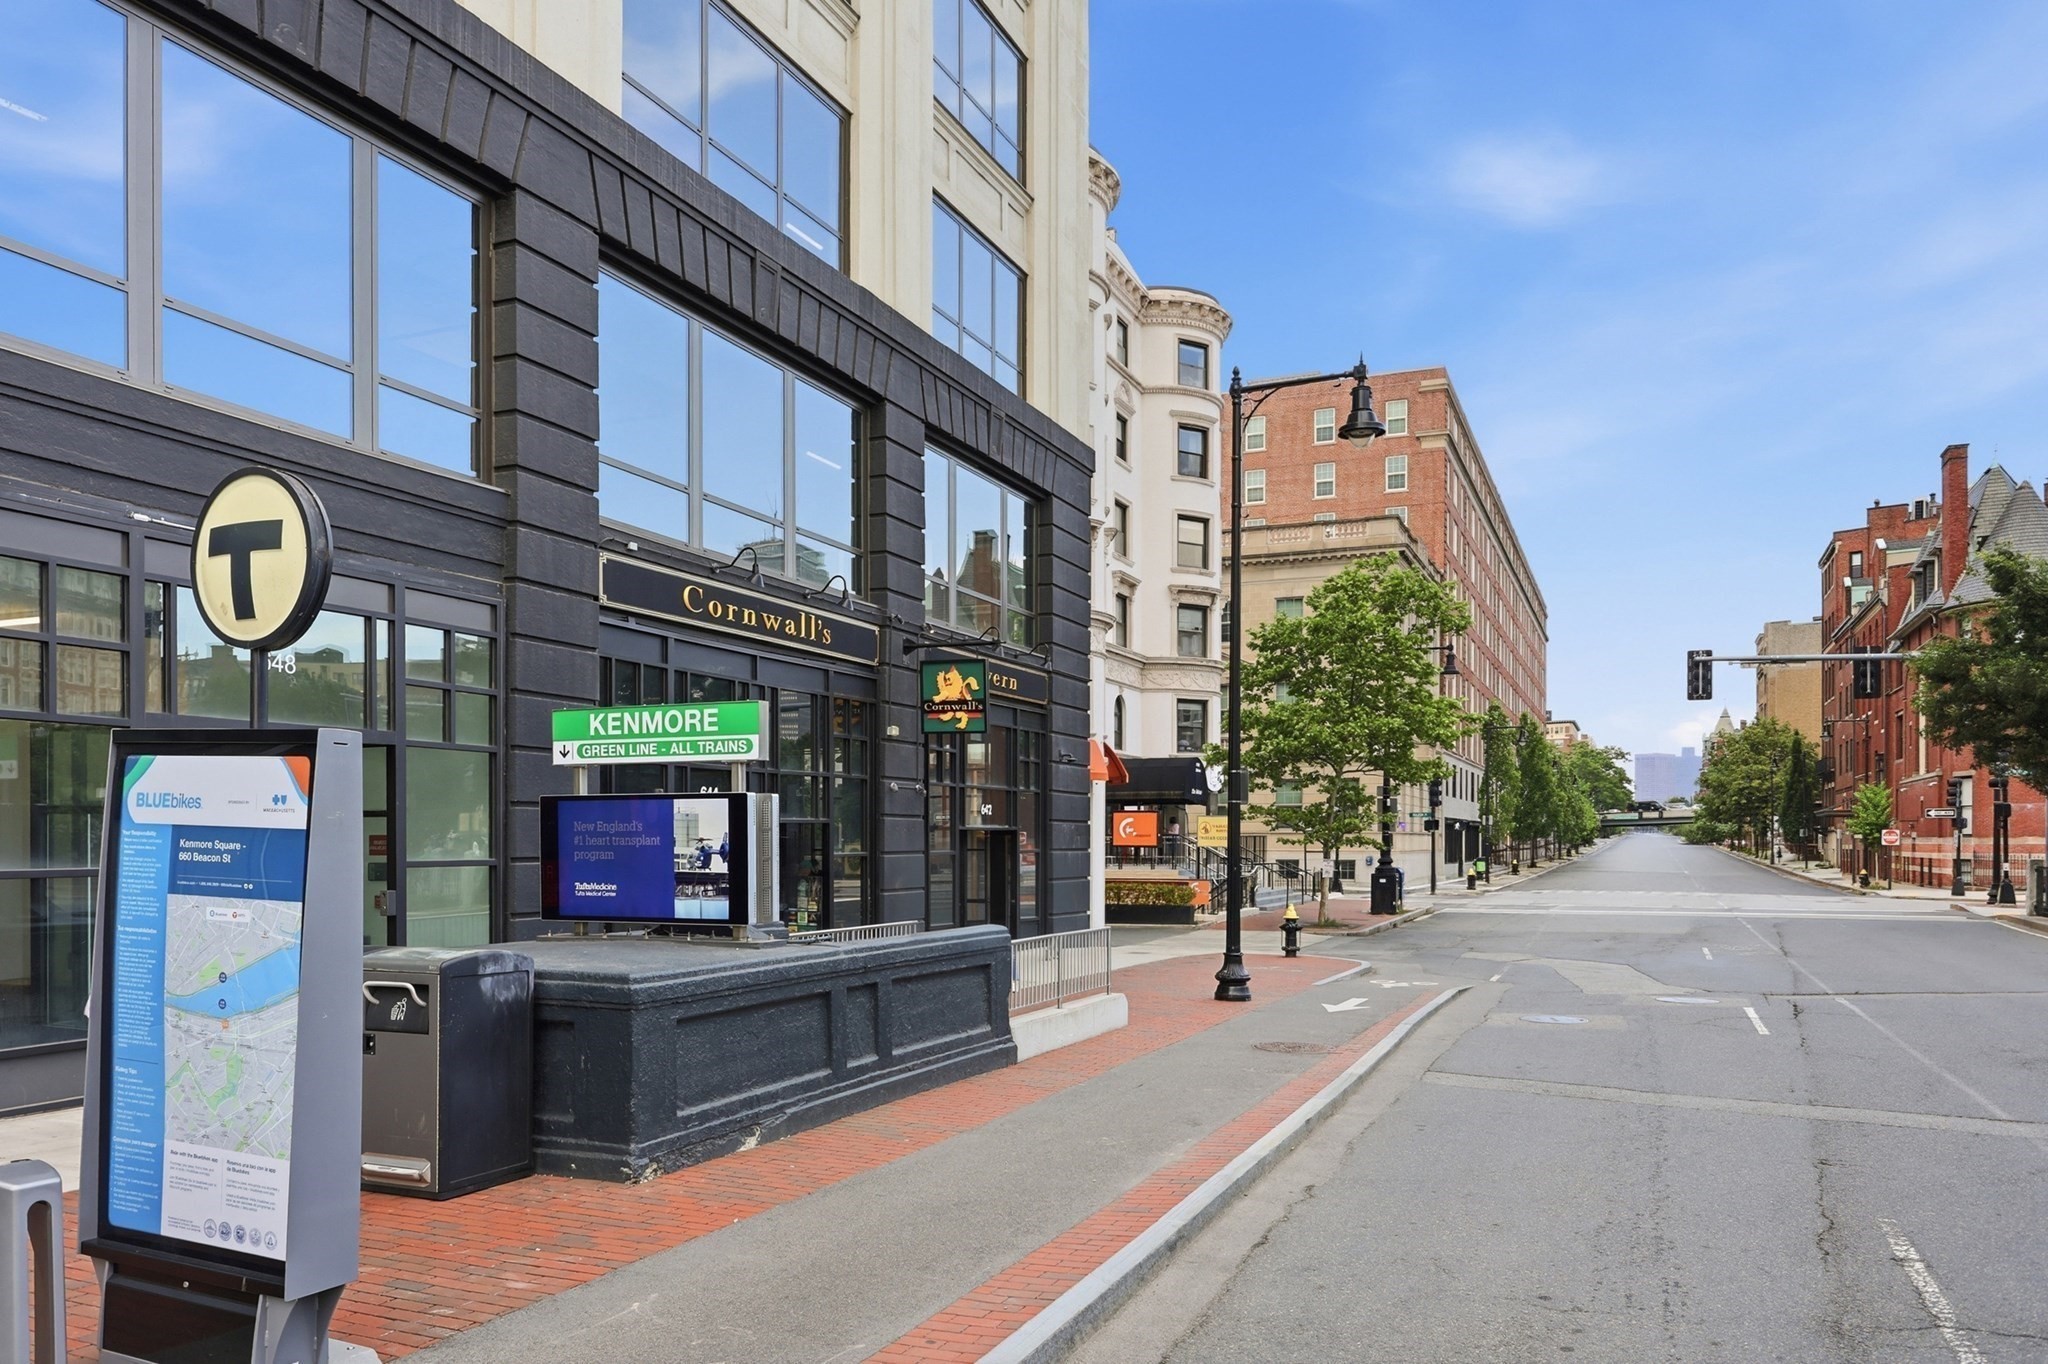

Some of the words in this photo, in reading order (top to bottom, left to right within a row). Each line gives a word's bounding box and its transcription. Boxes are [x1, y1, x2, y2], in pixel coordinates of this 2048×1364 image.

[208, 518, 284, 621] T
[682, 584, 832, 645] Cornwall's
[924, 702, 984, 711] Cornwall's
[589, 708, 719, 736] KENMORE
[582, 744, 626, 757] GREEN
[629, 742, 657, 756] LINE
[669, 742, 694, 755] ALL
[697, 739, 747, 753] TRAINS
[136, 792, 202, 809] BLUEbikes
[981, 804, 993, 816] 642
[573, 821, 595, 832] New
[597, 820, 643, 834] England's
[179, 839, 213, 849] Kenmore
[214, 840, 241, 851] Square
[574, 835, 584, 846] #1
[585, 834, 610, 846] heart
[612, 834, 661, 848] transplant
[178, 852, 192, 861] 660
[193, 852, 221, 862] Beacon
[222, 853, 231, 863] St
[574, 851, 615, 862] program
